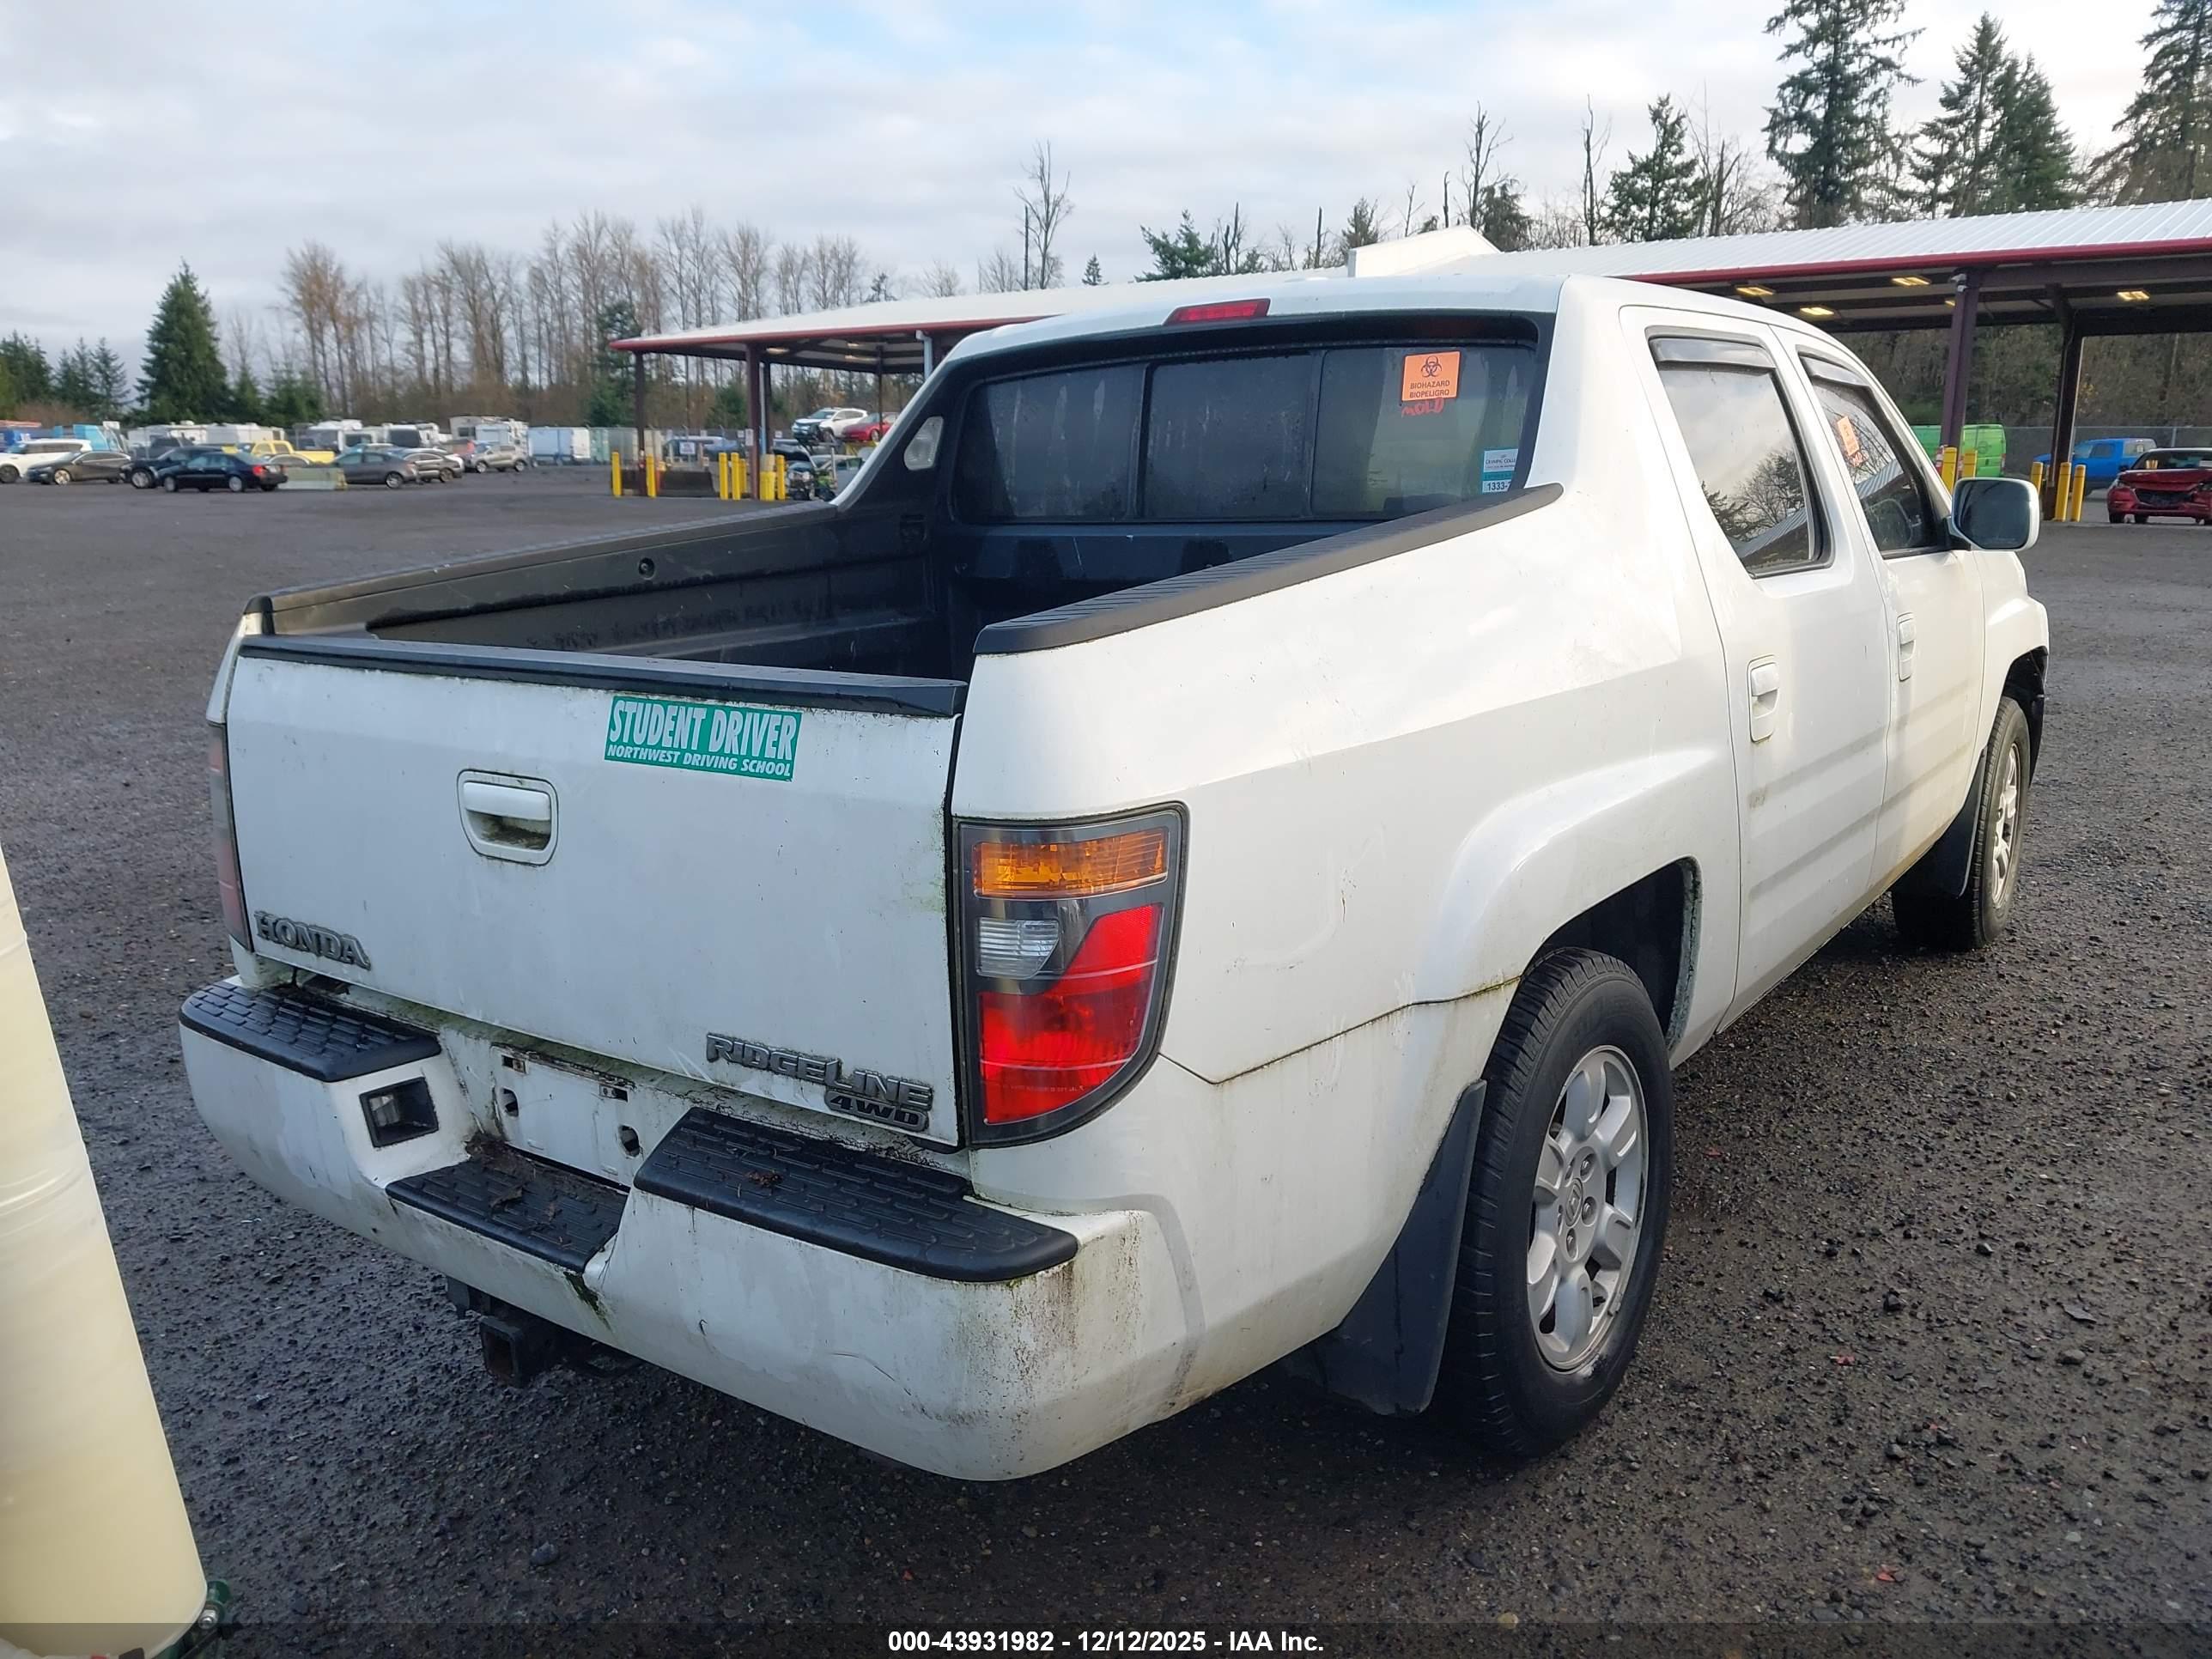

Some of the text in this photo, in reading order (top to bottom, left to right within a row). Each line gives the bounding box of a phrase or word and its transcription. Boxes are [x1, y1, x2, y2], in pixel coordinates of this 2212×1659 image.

[1409, 389, 1449, 398] BIOPELIGRO
[1410, 380, 1450, 389] BIOHAZARD
[610, 700, 797, 760] STUDENT DRIVER
[607, 744, 792, 777] NORTHWEST DRIVING SCHOOL
[254, 910, 372, 971] HONDA
[706, 1032, 934, 1111] RIDGELINE
[828, 1092, 926, 1128] 4WD
